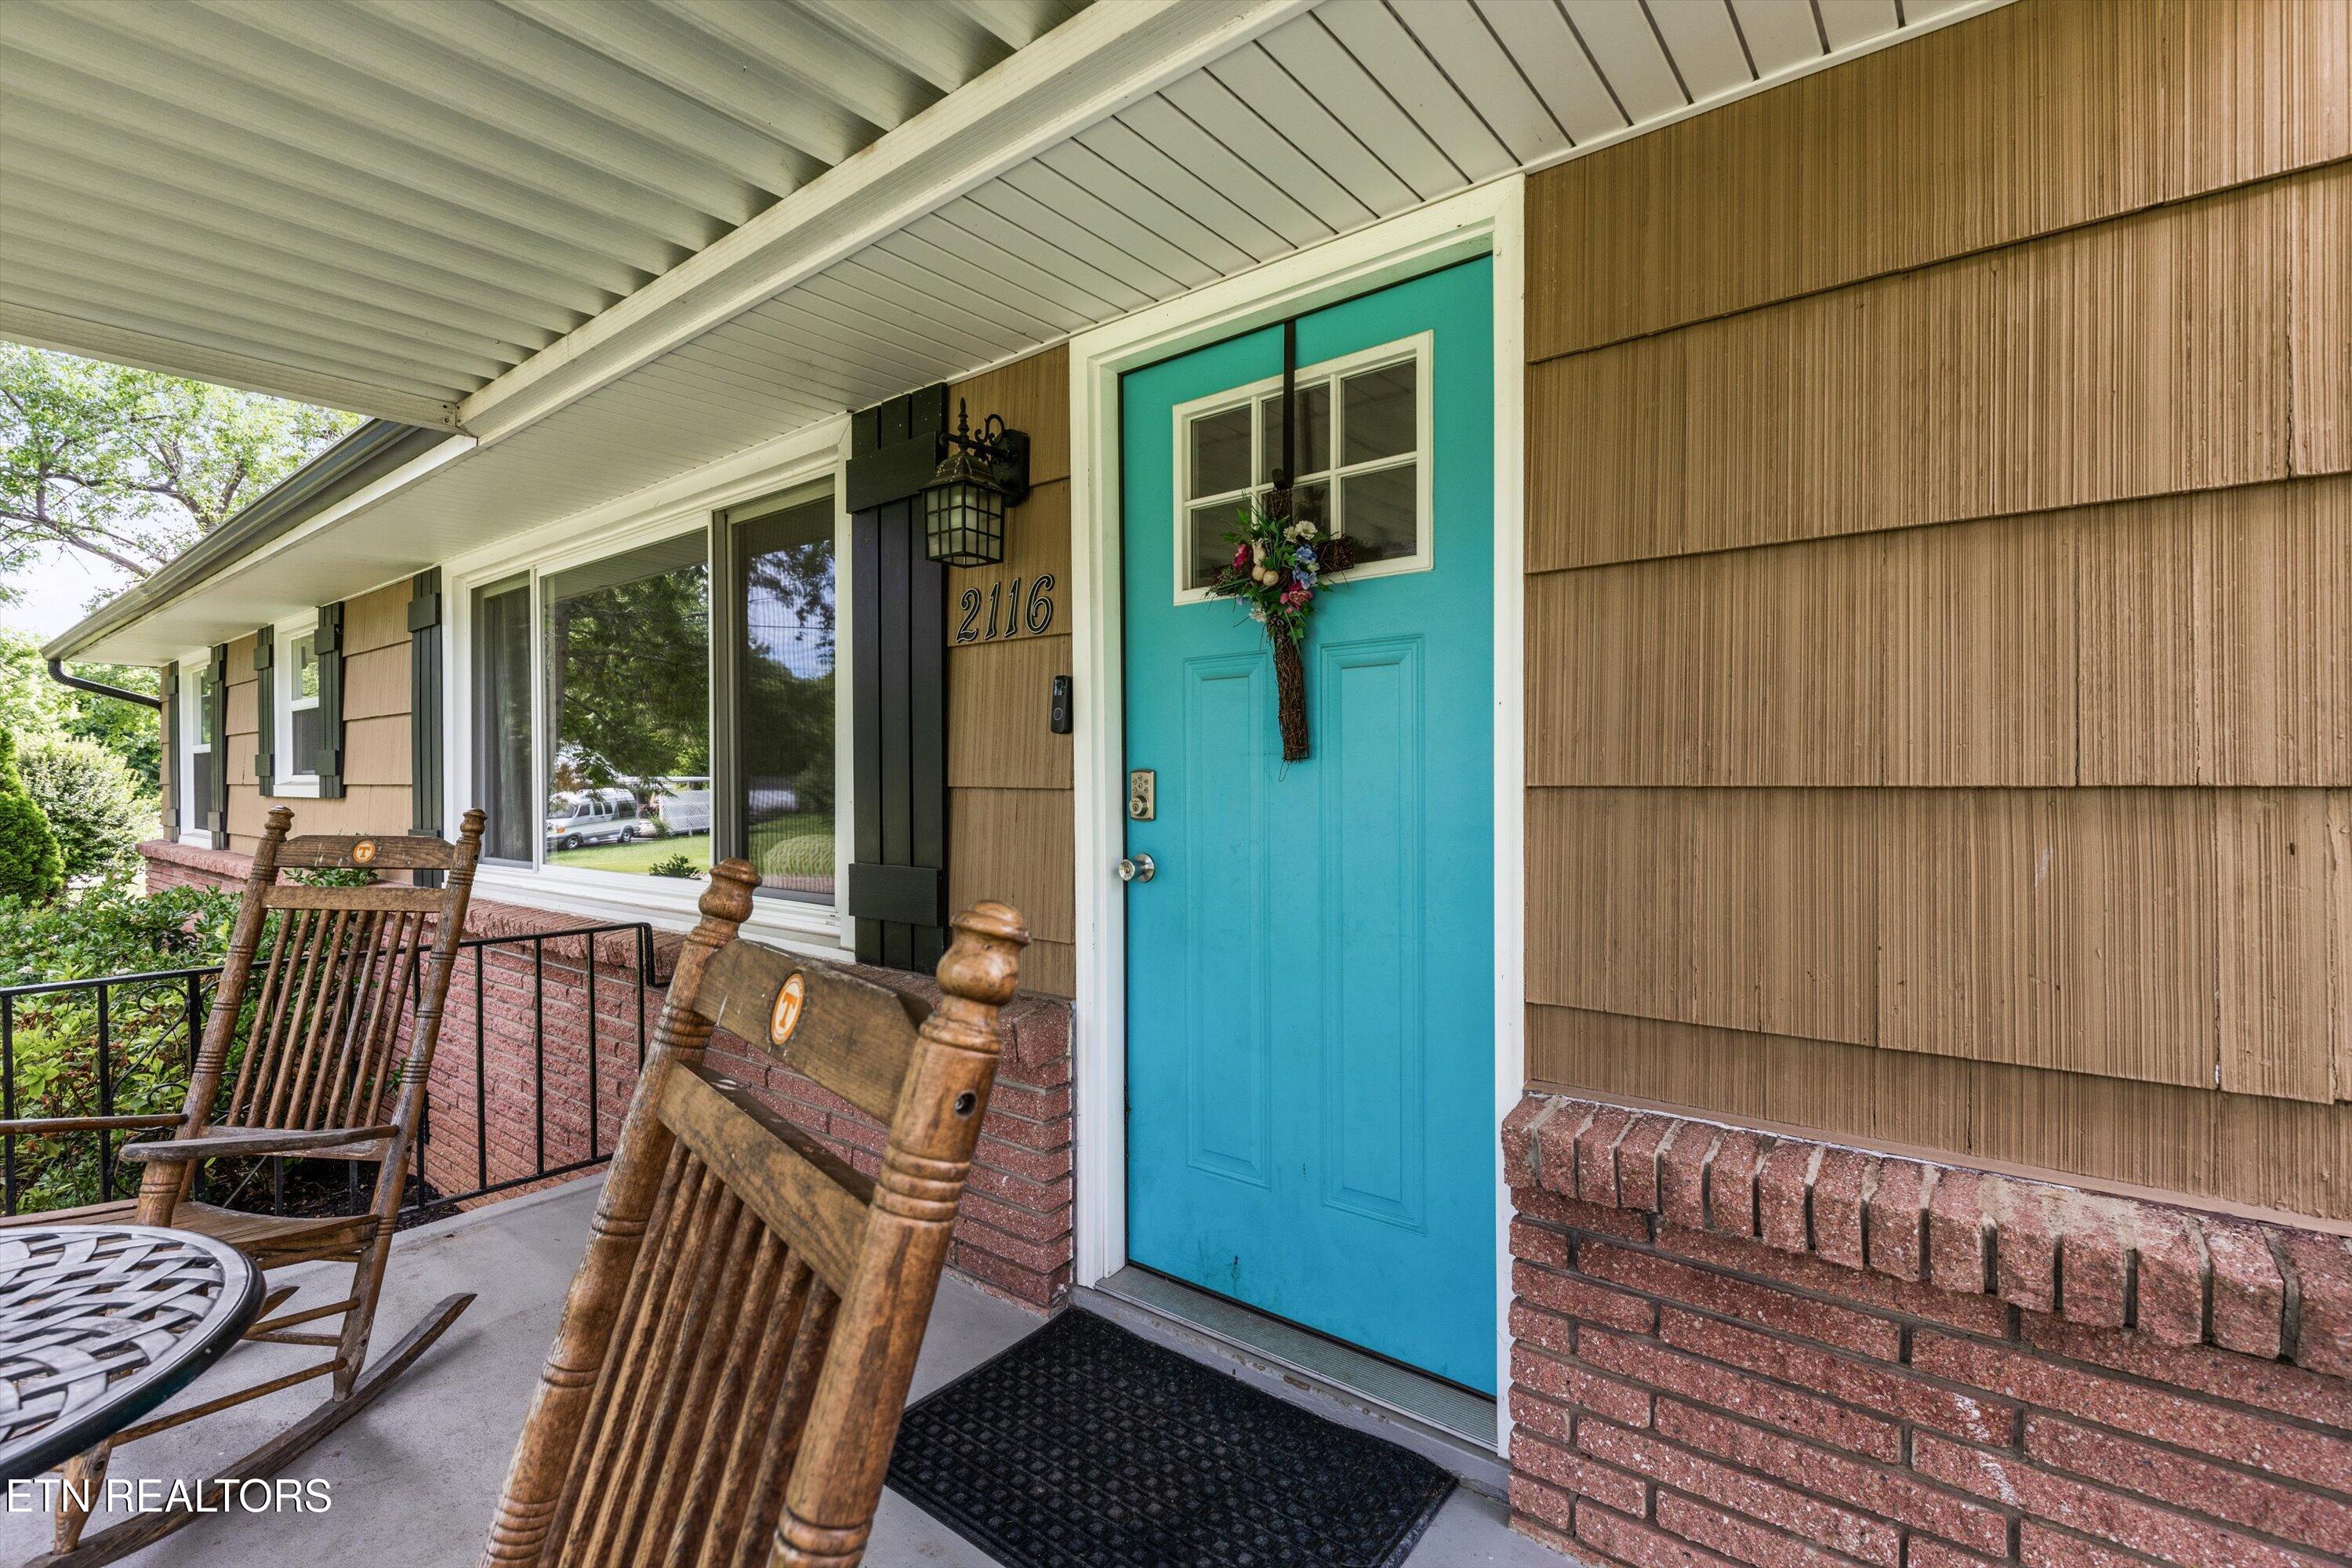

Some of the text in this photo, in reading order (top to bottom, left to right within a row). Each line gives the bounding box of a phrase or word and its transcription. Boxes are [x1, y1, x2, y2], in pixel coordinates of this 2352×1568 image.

[956, 574, 1054, 643] 2116
[358, 846, 372, 858] T
[779, 991, 799, 1029] T
